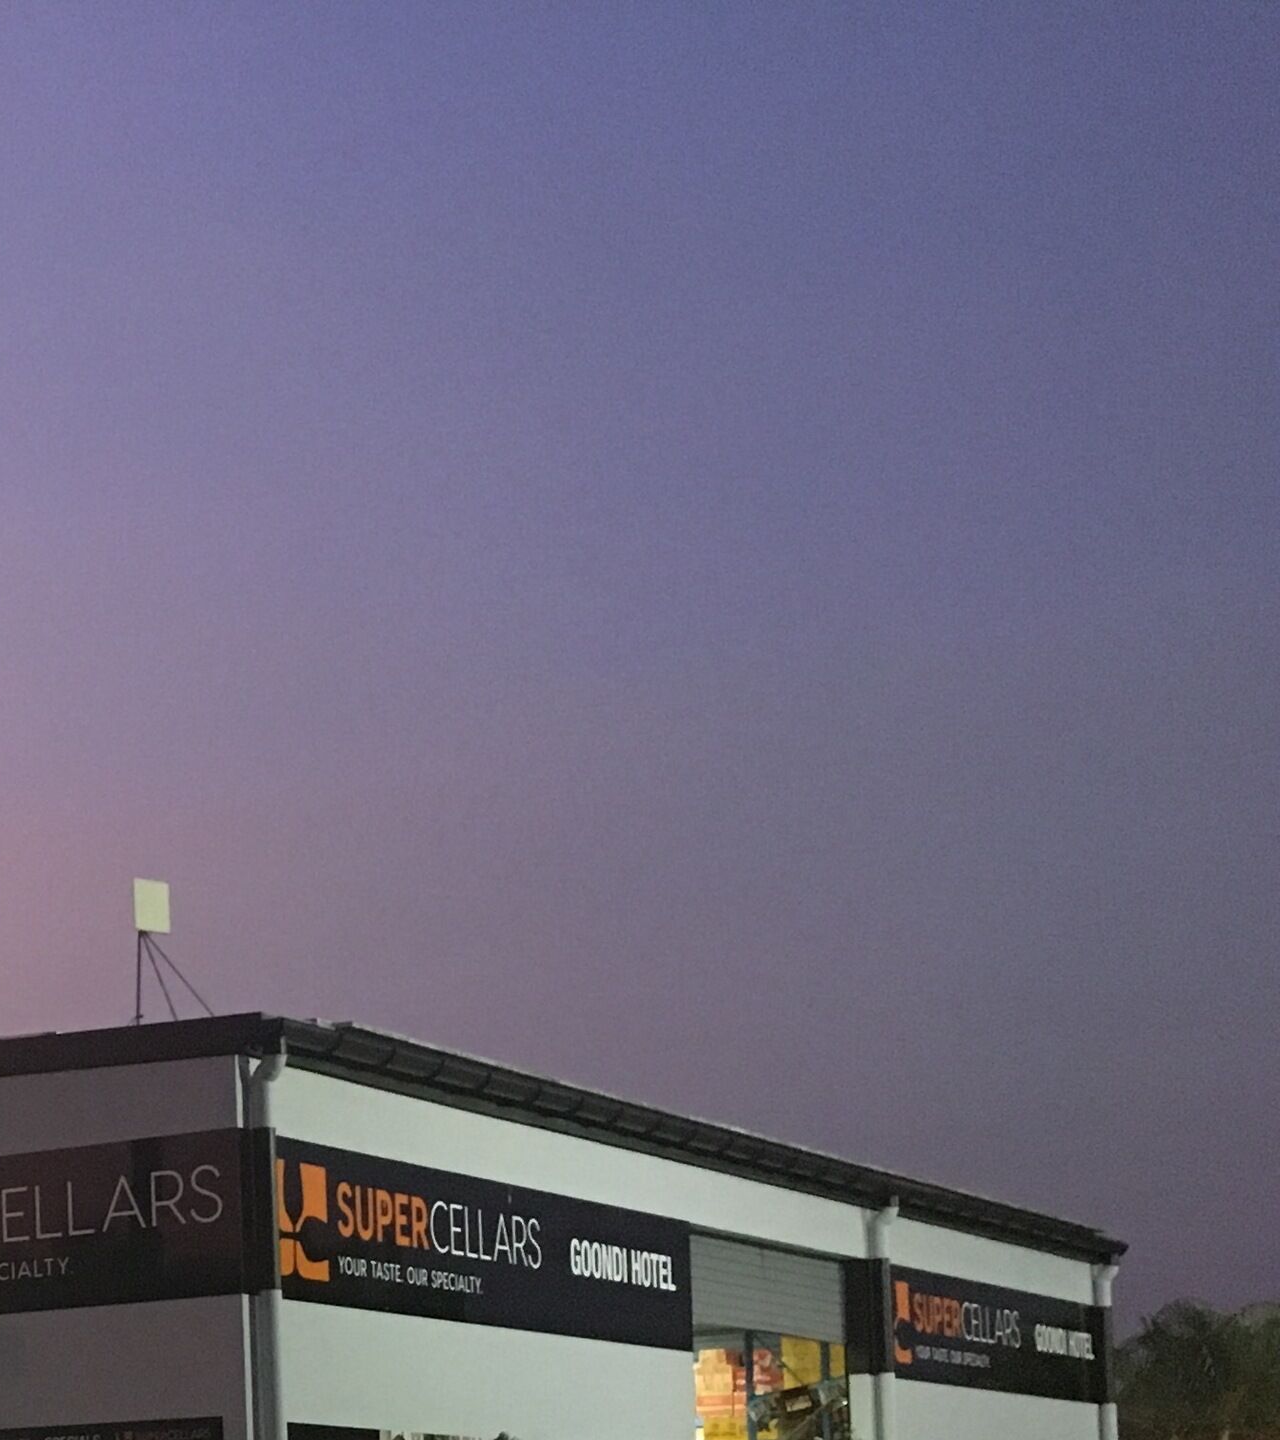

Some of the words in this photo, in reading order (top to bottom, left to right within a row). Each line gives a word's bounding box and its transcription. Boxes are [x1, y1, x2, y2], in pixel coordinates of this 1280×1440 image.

[338, 1255, 368, 1278] YOUR
[406, 1265, 429, 1289] OUR
[569, 1237, 628, 1283] GOONDI
[630, 1249, 677, 1291] HOTEL
